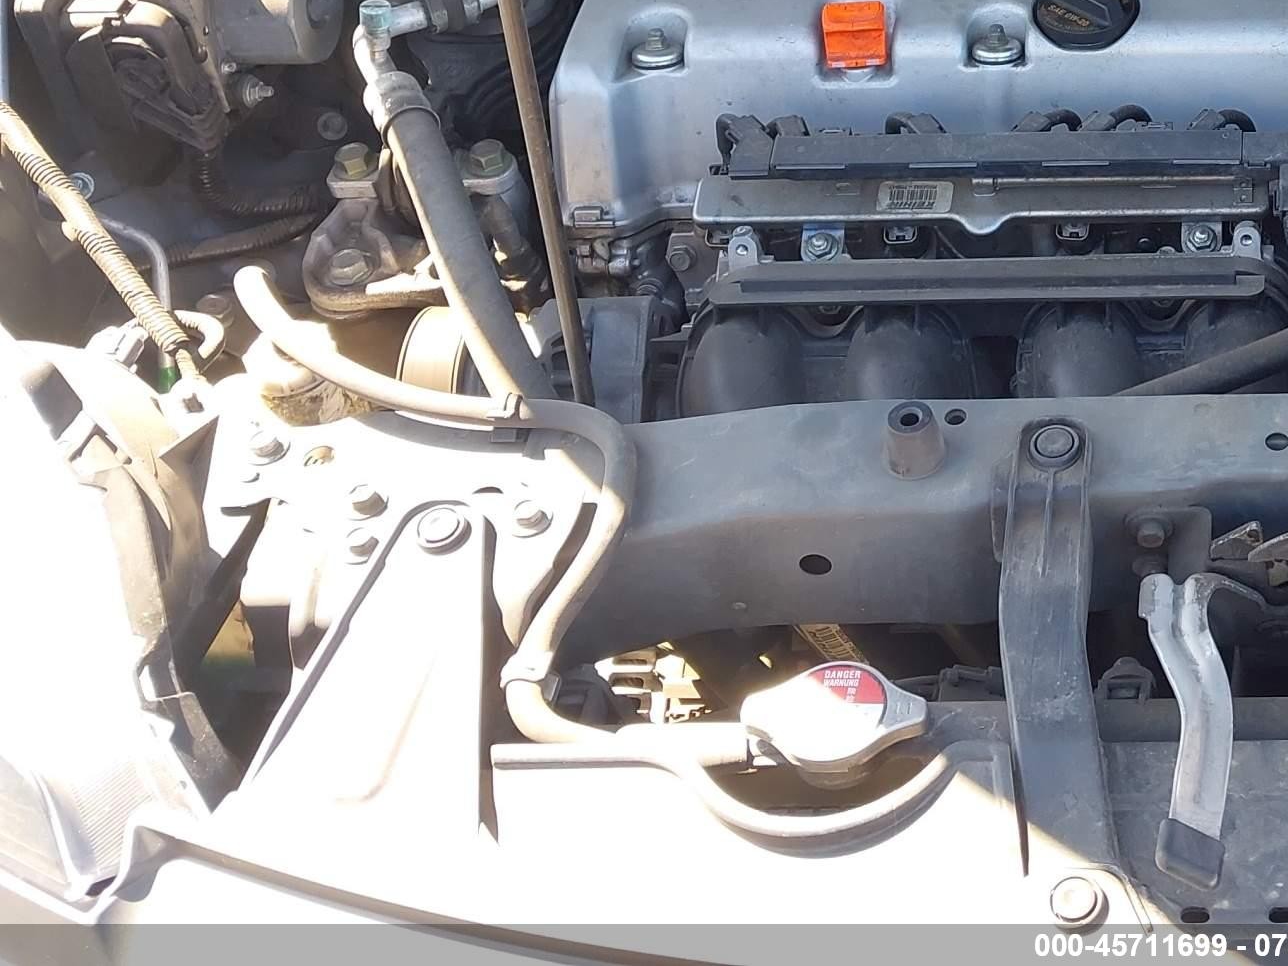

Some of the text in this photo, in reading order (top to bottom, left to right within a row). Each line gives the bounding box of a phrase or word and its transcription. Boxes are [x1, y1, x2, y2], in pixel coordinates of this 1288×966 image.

[1047, 3, 1067, 16] SAE
[824, 670, 861, 679] DANGER
[823, 678, 859, 687] WARNUNG
